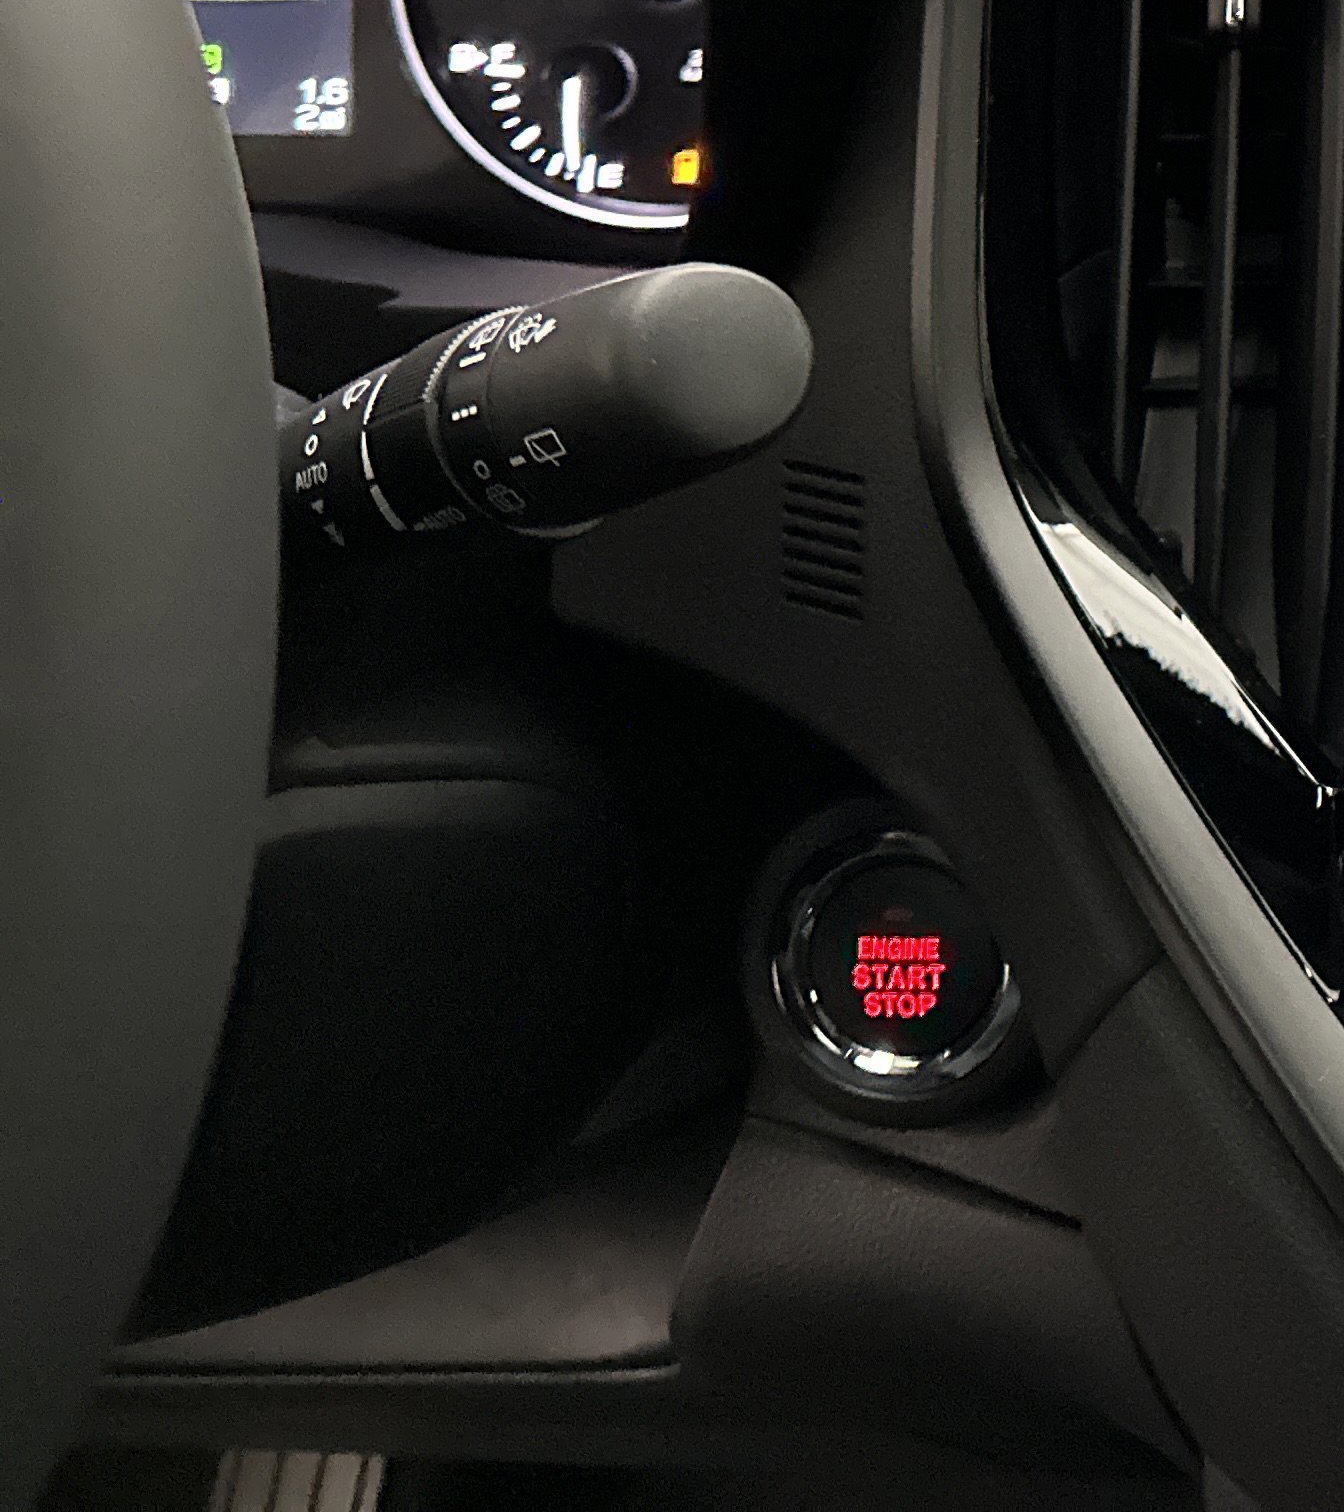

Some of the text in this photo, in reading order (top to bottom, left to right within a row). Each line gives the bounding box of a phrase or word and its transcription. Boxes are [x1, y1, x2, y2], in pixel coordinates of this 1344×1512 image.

[296, 461, 328, 493] AUTO
[858, 937, 940, 960] ENGINE
[853, 964, 946, 989] START
[864, 992, 937, 1018] STOP
